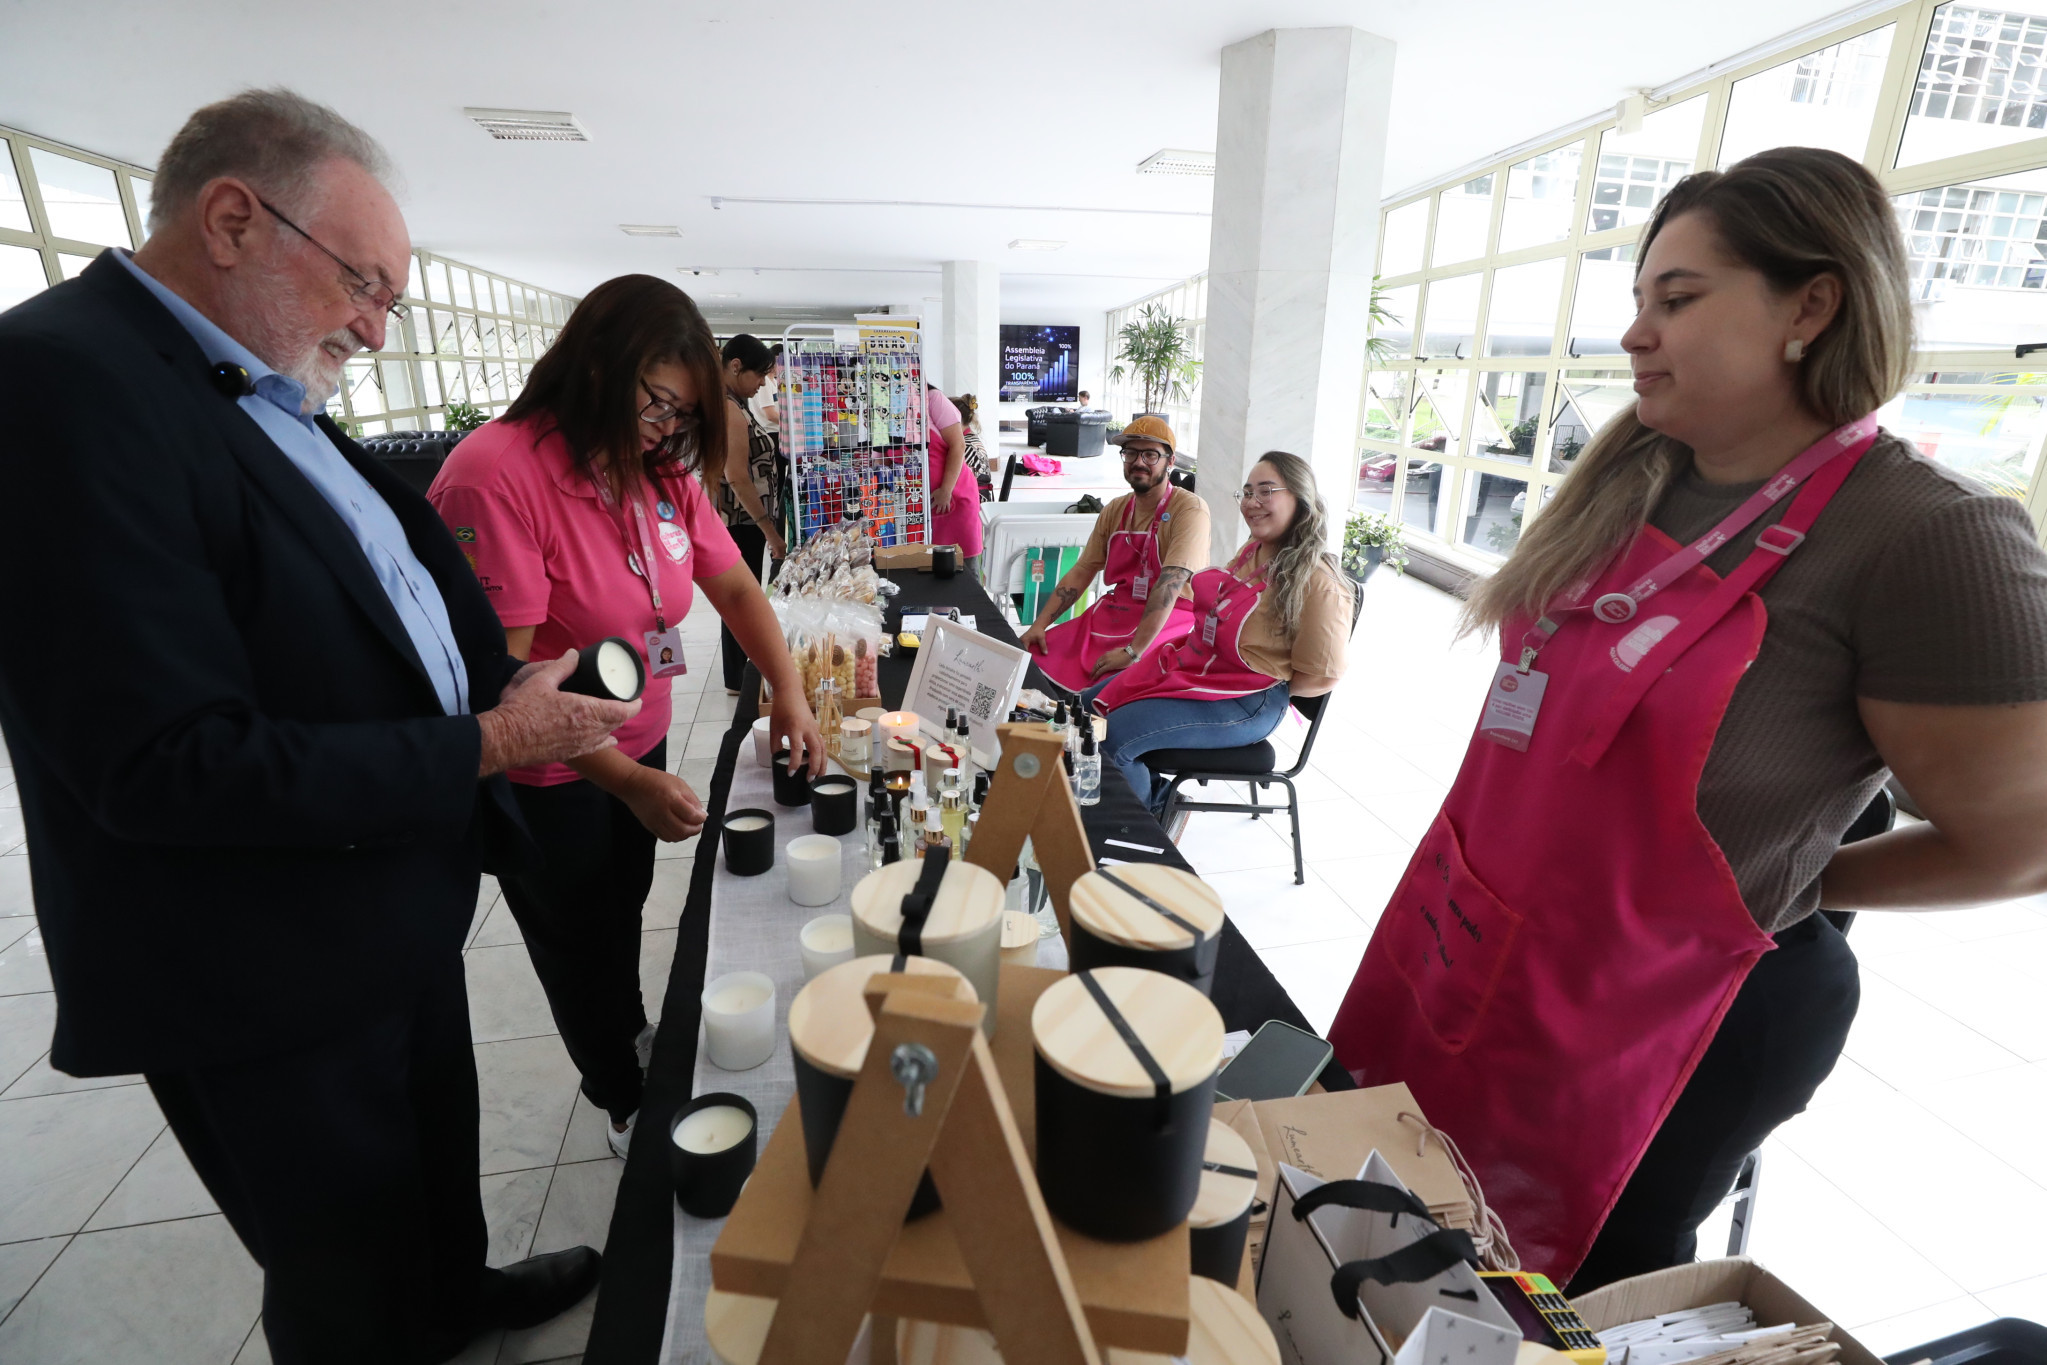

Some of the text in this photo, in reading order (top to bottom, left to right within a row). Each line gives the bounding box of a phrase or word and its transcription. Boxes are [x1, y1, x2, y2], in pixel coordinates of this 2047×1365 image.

[1005, 345, 1045, 354] Assembleia
[1005, 354, 1042, 363] Legislativa
[1016, 362, 1040, 370] Paraná
[1011, 372, 1034, 380] 100%
